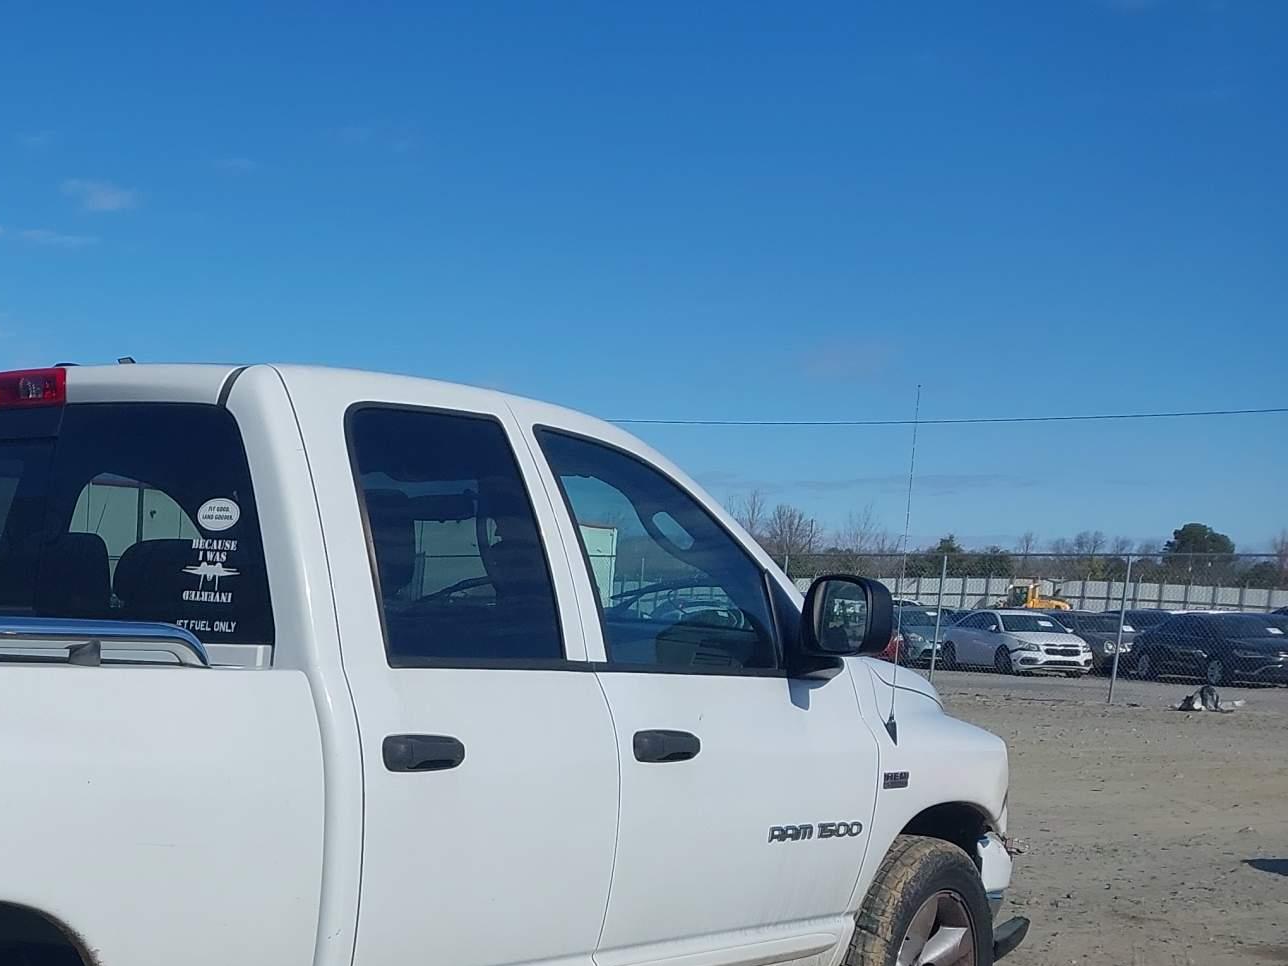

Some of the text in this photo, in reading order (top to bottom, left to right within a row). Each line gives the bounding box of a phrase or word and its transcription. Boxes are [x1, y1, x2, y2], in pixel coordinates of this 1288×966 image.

[192, 539, 237, 550] BECAUSE
[198, 550, 227, 562] I WAS
[182, 591, 232, 602] INVERTED
[190, 620, 211, 631] FUEL
[213, 621, 236, 632] ONLY
[768, 821, 863, 843] RAM 1500
